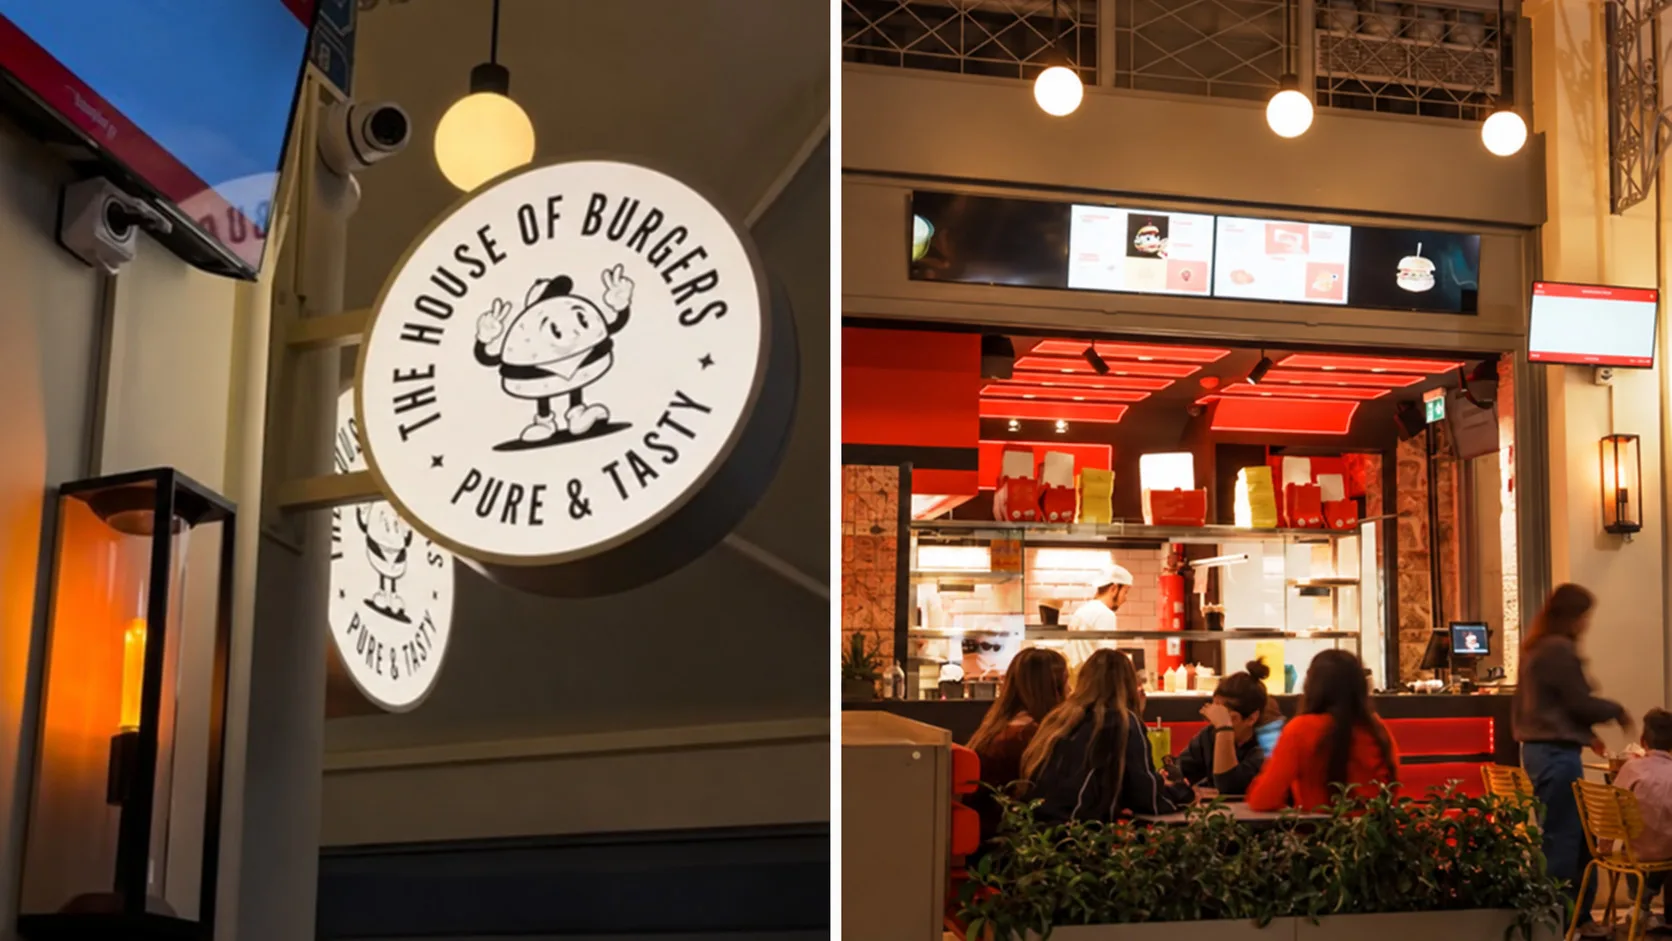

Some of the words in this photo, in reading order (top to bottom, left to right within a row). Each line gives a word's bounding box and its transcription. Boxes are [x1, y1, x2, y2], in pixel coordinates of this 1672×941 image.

[517, 194, 563, 246] OF
[580, 192, 728, 328] BURGERS
[400, 224, 507, 346] HOUSE
[393, 363, 442, 442] THE
[451, 467, 548, 526] PURE
[566, 478, 593, 520] &
[601, 389, 713, 501] TASTY
[346, 611, 383, 676] PURE
[389, 646, 399, 680] &
[402, 608, 437, 677] TASTY
